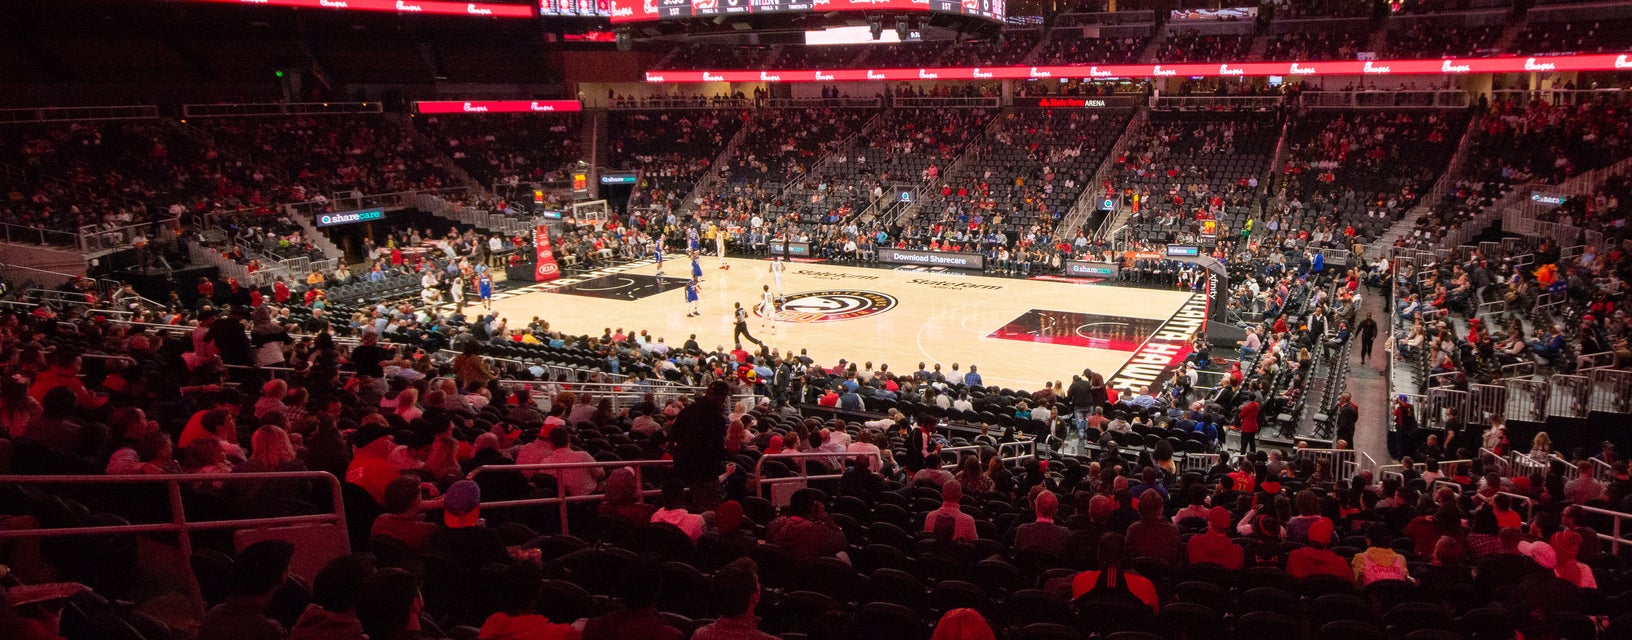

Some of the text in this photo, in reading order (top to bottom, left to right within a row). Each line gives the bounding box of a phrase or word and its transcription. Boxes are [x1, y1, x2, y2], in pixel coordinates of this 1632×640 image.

[669, 8, 680, 16] 1ST
[331, 211, 380, 223] sharecare
[893, 252, 967, 266] Download Sharecare
[542, 264, 555, 272] KIA
[1209, 273, 1219, 300] xfinity
